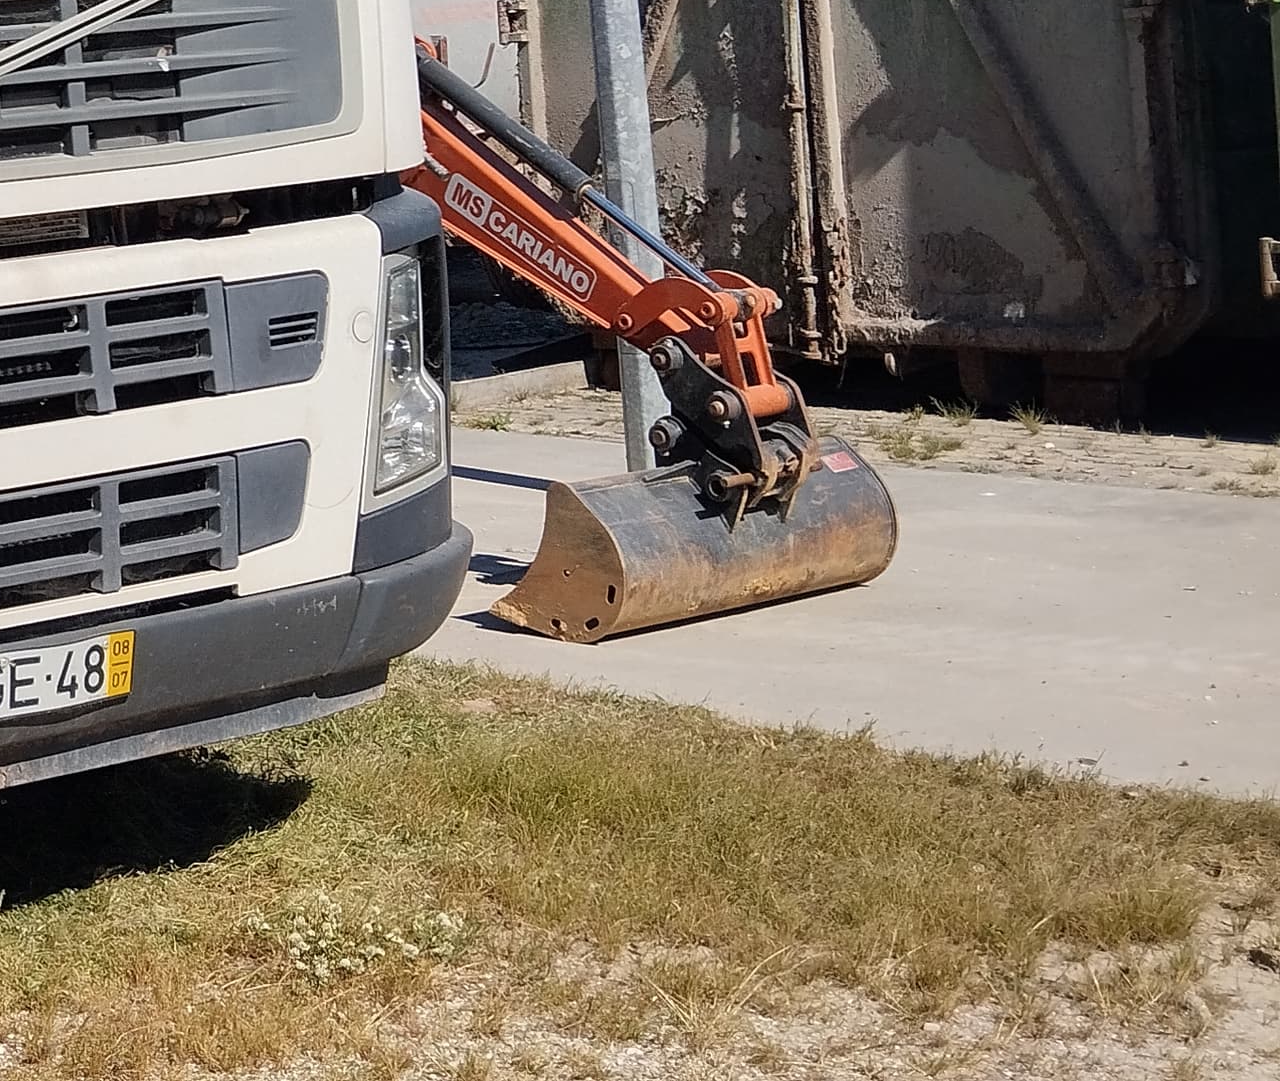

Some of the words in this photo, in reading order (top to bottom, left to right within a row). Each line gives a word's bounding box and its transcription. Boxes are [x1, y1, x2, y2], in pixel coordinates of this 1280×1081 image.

[452, 182, 485, 219] MS
[489, 211, 590, 294] CARIANO
[113, 639, 130, 656] 08
[111, 670, 128, 688] 07
